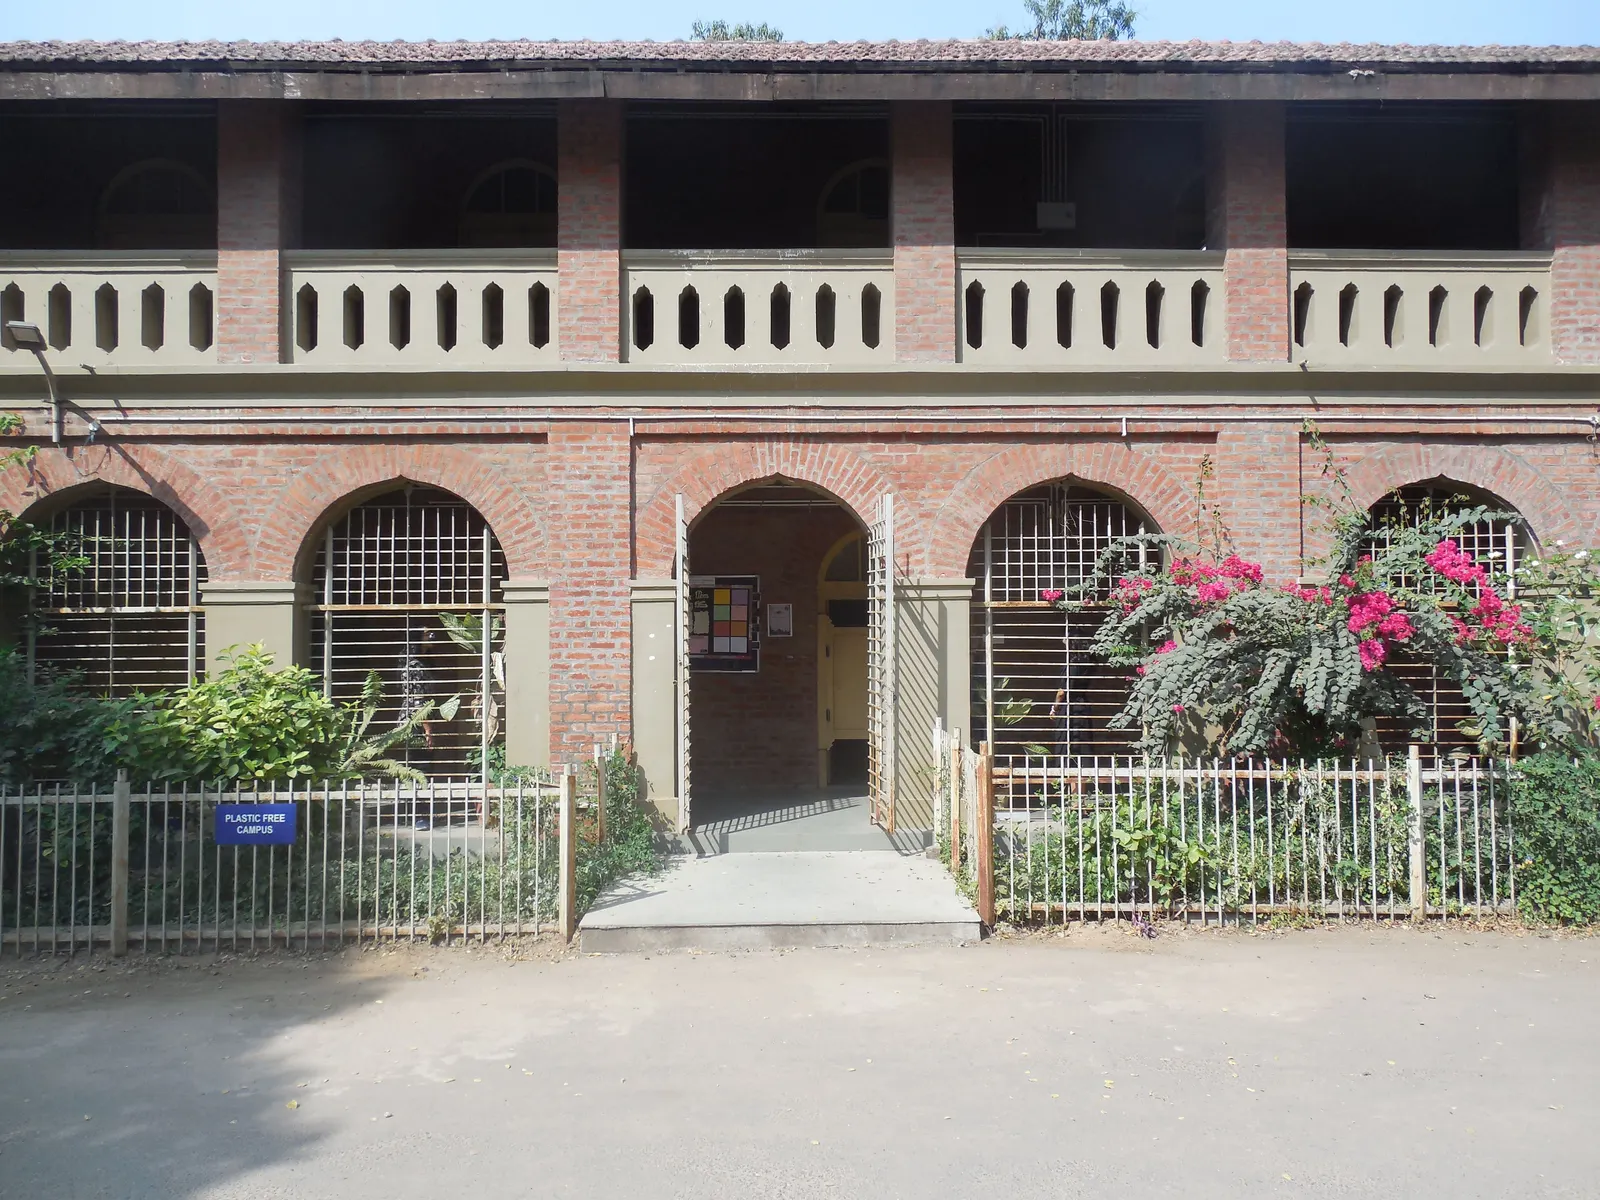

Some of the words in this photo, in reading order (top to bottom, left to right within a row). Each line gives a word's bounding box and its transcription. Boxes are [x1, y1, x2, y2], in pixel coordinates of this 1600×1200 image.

[225, 814, 261, 823] PLASTIC
[262, 814, 286, 823] FREE
[236, 825, 273, 834] CAMPUS
